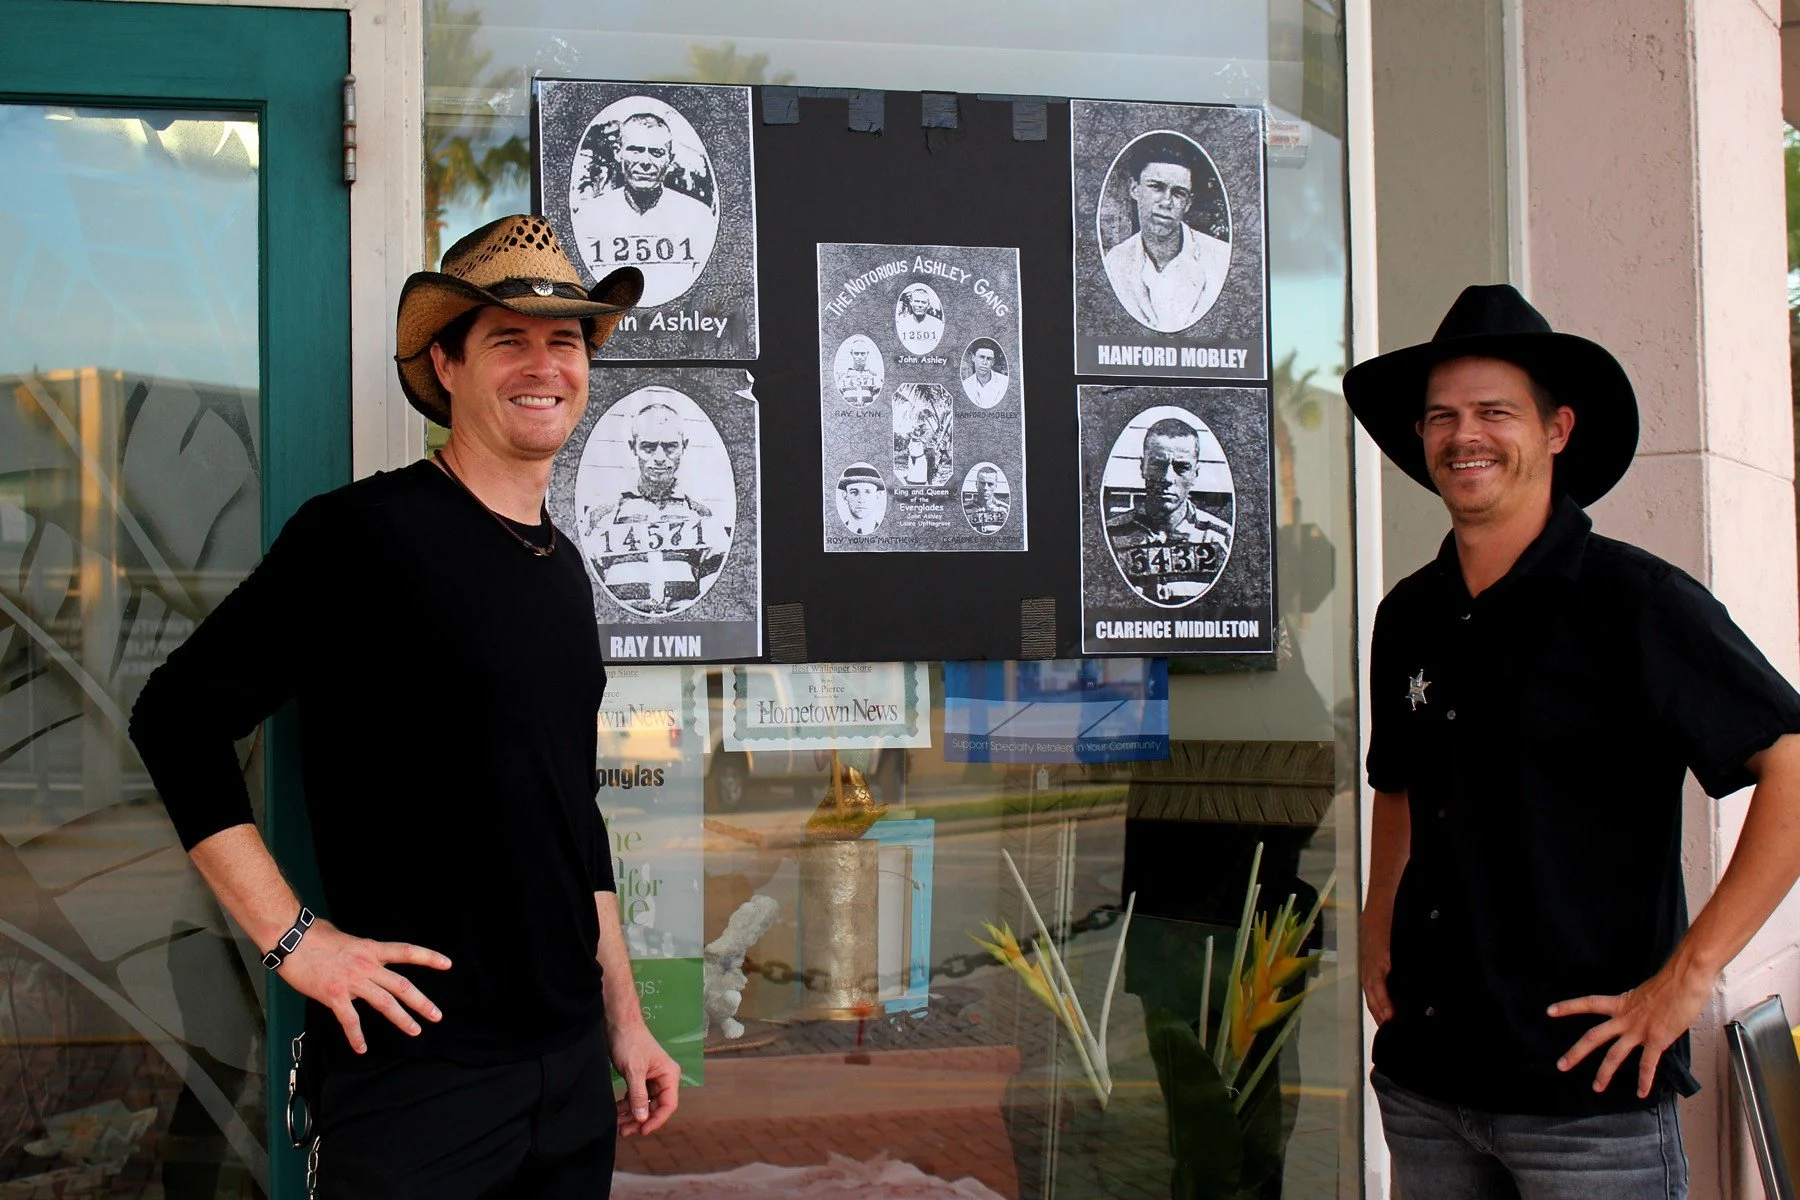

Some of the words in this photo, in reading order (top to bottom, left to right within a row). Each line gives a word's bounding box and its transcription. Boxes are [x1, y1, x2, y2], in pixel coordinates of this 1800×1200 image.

[591, 237, 695, 263] 12501
[825, 291, 852, 316] THE
[844, 260, 908, 299] NOTORIOUS
[913, 256, 972, 284] ASHLEY
[973, 279, 1009, 317] GANG
[649, 311, 728, 338] Ashley
[902, 332, 937, 341] 12501
[898, 355, 918, 364] John
[921, 355, 948, 366] Ashley
[1097, 345, 1177, 367] HANFORD
[1181, 347, 1248, 369] MOBLEY
[834, 410, 853, 418] RAY
[856, 410, 882, 418] LYNN
[988, 412, 1019, 420] MOBLEY
[893, 488, 909, 497] King
[926, 488, 949, 497] Queen
[899, 503, 944, 514] Everglades
[601, 521, 706, 553] 14571
[826, 536, 844, 545] ROY
[1129, 542, 1217, 575] 5432
[1095, 620, 1171, 639] CLARENCE
[1174, 620, 1259, 638] MIDDLETON
[610, 635, 648, 658] RAY
[653, 635, 701, 658] LYNN
[618, 668, 639, 677] Store
[792, 664, 808, 673] Best
[811, 664, 850, 674] Wallpaper
[852, 663, 872, 673] Store
[808, 685, 819, 693] Ft.
[821, 685, 845, 693] Pierce
[628, 703, 675, 727] News
[758, 700, 849, 724] Hometown
[852, 698, 898, 722] News
[952, 739, 989, 751] Support
[990, 741, 1035, 754] Specialty
[1036, 741, 1074, 752] Retailers
[1086, 742, 1107, 751] Your
[1108, 739, 1162, 752] Community
[596, 765, 664, 789] ouglas
[628, 868, 663, 898] for
